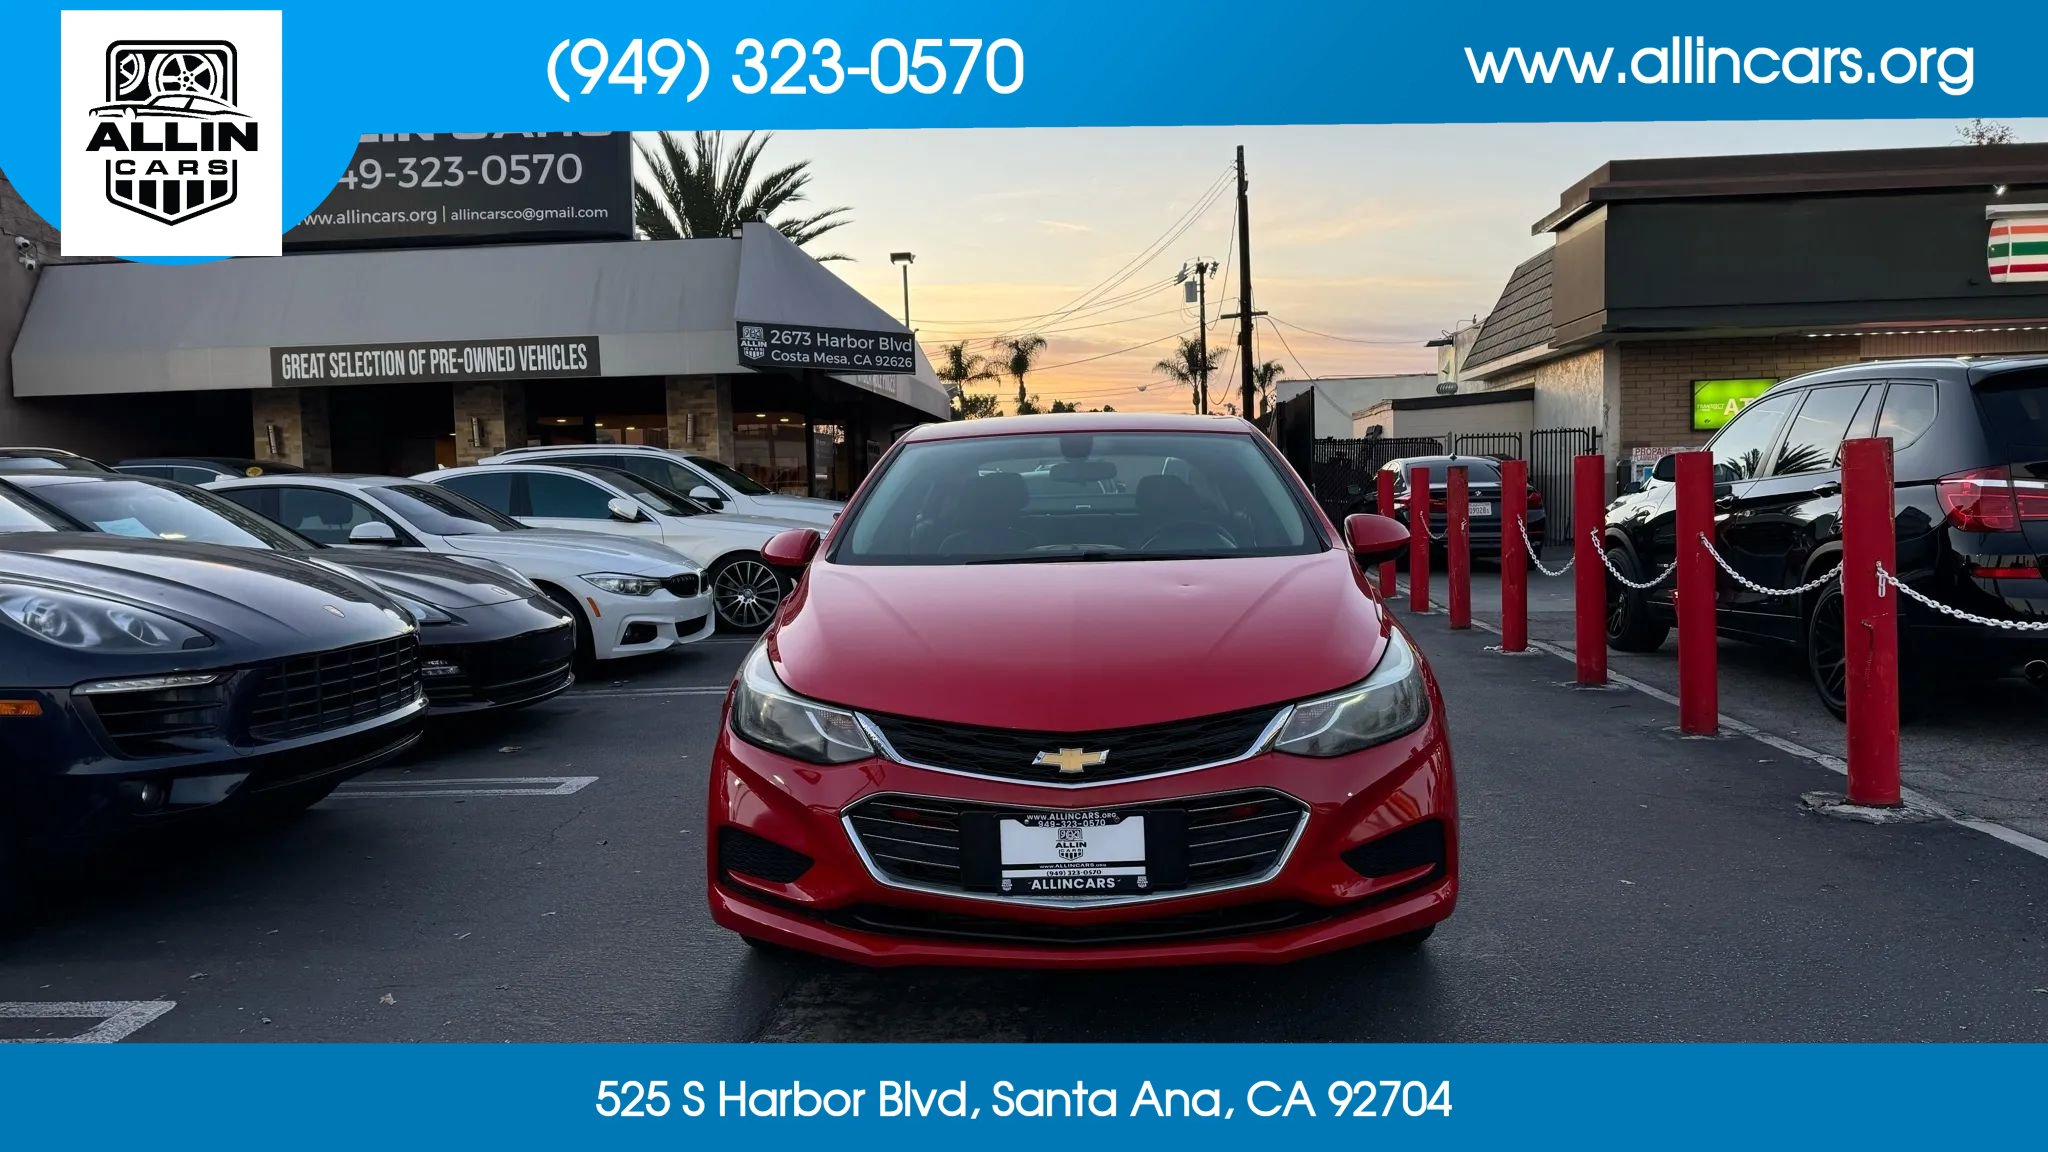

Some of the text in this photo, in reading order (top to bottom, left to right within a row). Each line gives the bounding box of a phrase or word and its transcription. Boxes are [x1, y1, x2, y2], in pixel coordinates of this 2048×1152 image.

[297, 206, 609, 225] ww.allincars.org allincarsco@gmail.com
[740, 340, 767, 348] ALLIN
[770, 329, 912, 352] 2673 Harbor Blvd
[281, 343, 588, 380] GREAT SELECTION OF PRE-OWNED VEHICLES
[771, 349, 913, 368] Costa Mesa, CA 92626
[1635, 447, 1673, 456] PROPANE
[1038, 819, 1106, 828] 949-323-0570
[1031, 878, 1116, 890] ALLINCARS
